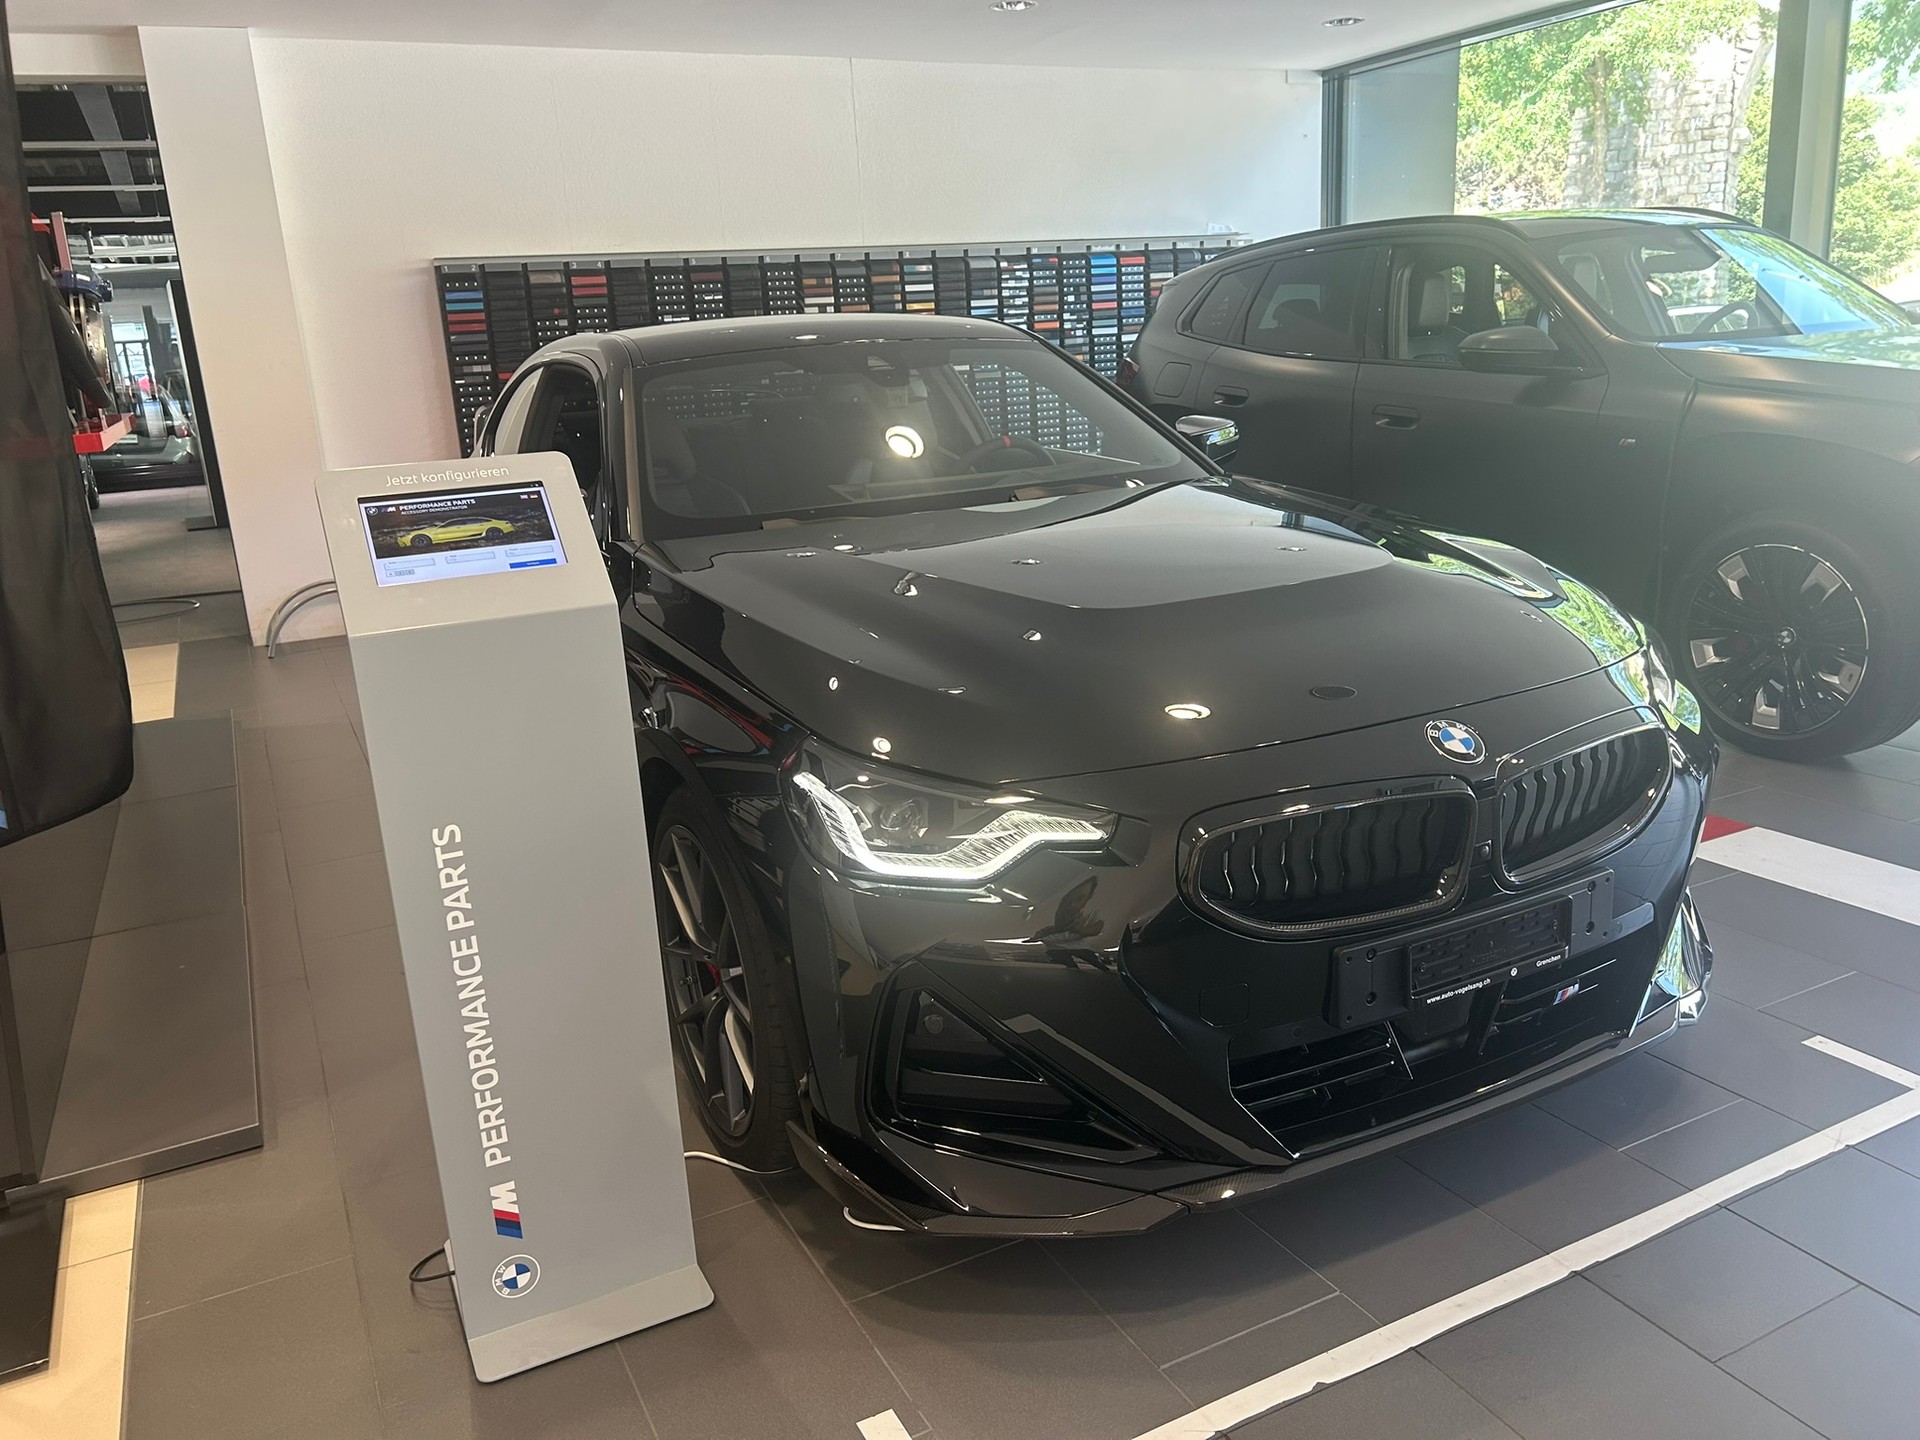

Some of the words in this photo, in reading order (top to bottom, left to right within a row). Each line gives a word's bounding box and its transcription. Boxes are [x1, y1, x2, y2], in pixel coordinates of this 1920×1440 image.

[470, 264, 476, 272] 2
[571, 261, 577, 269] 3
[596, 260, 602, 268] 4
[386, 474, 419, 487] Jetzt
[420, 467, 510, 483] konfigurieren
[399, 501, 452, 511] PERFORMANCE
[452, 498, 476, 506] PARTS
[428, 505, 468, 513] DEMONSTRATOR
[431, 823, 475, 932] PARTS
[1535, 954, 1561, 967] Grenchen
[1426, 978, 1491, 1004] www.auto-vogelsang.ch
[449, 935, 512, 1168] PERFORMANCE
